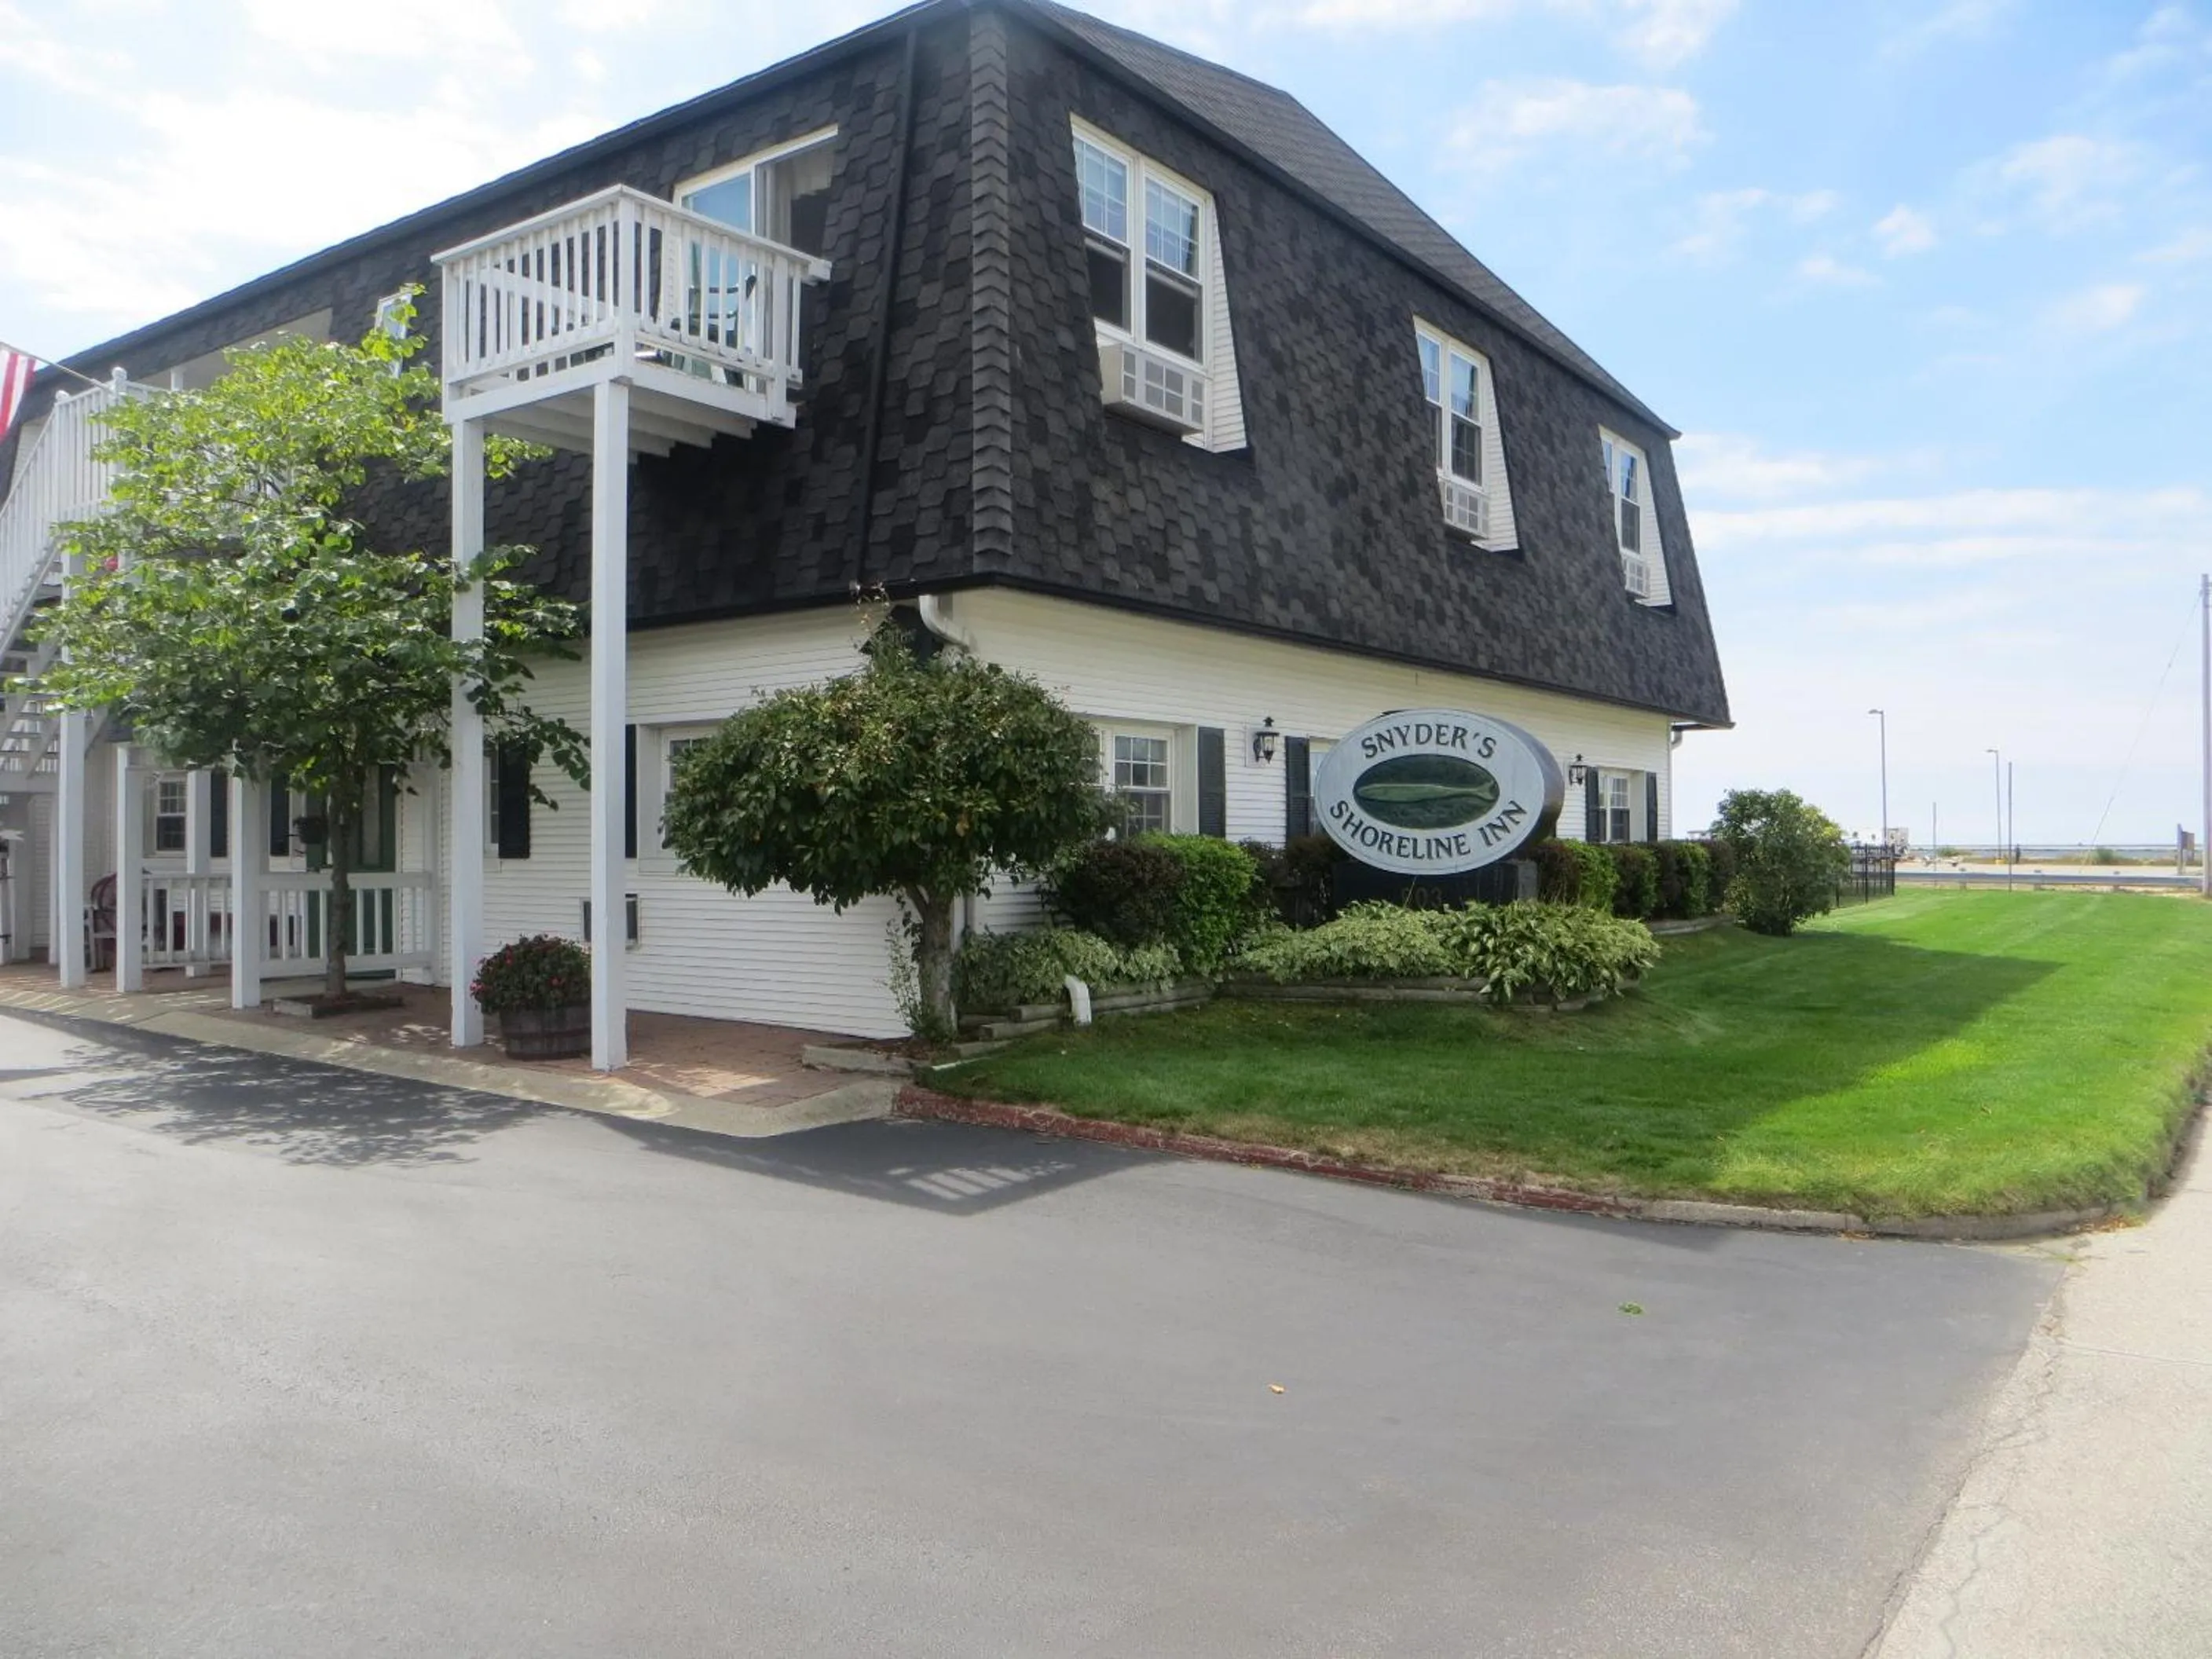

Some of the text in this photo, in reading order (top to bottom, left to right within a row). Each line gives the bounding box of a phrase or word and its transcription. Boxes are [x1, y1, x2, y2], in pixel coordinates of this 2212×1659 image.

[1361, 723, 1496, 759] SNYDER'S
[1330, 800, 1527, 859] SHORELINE INN
